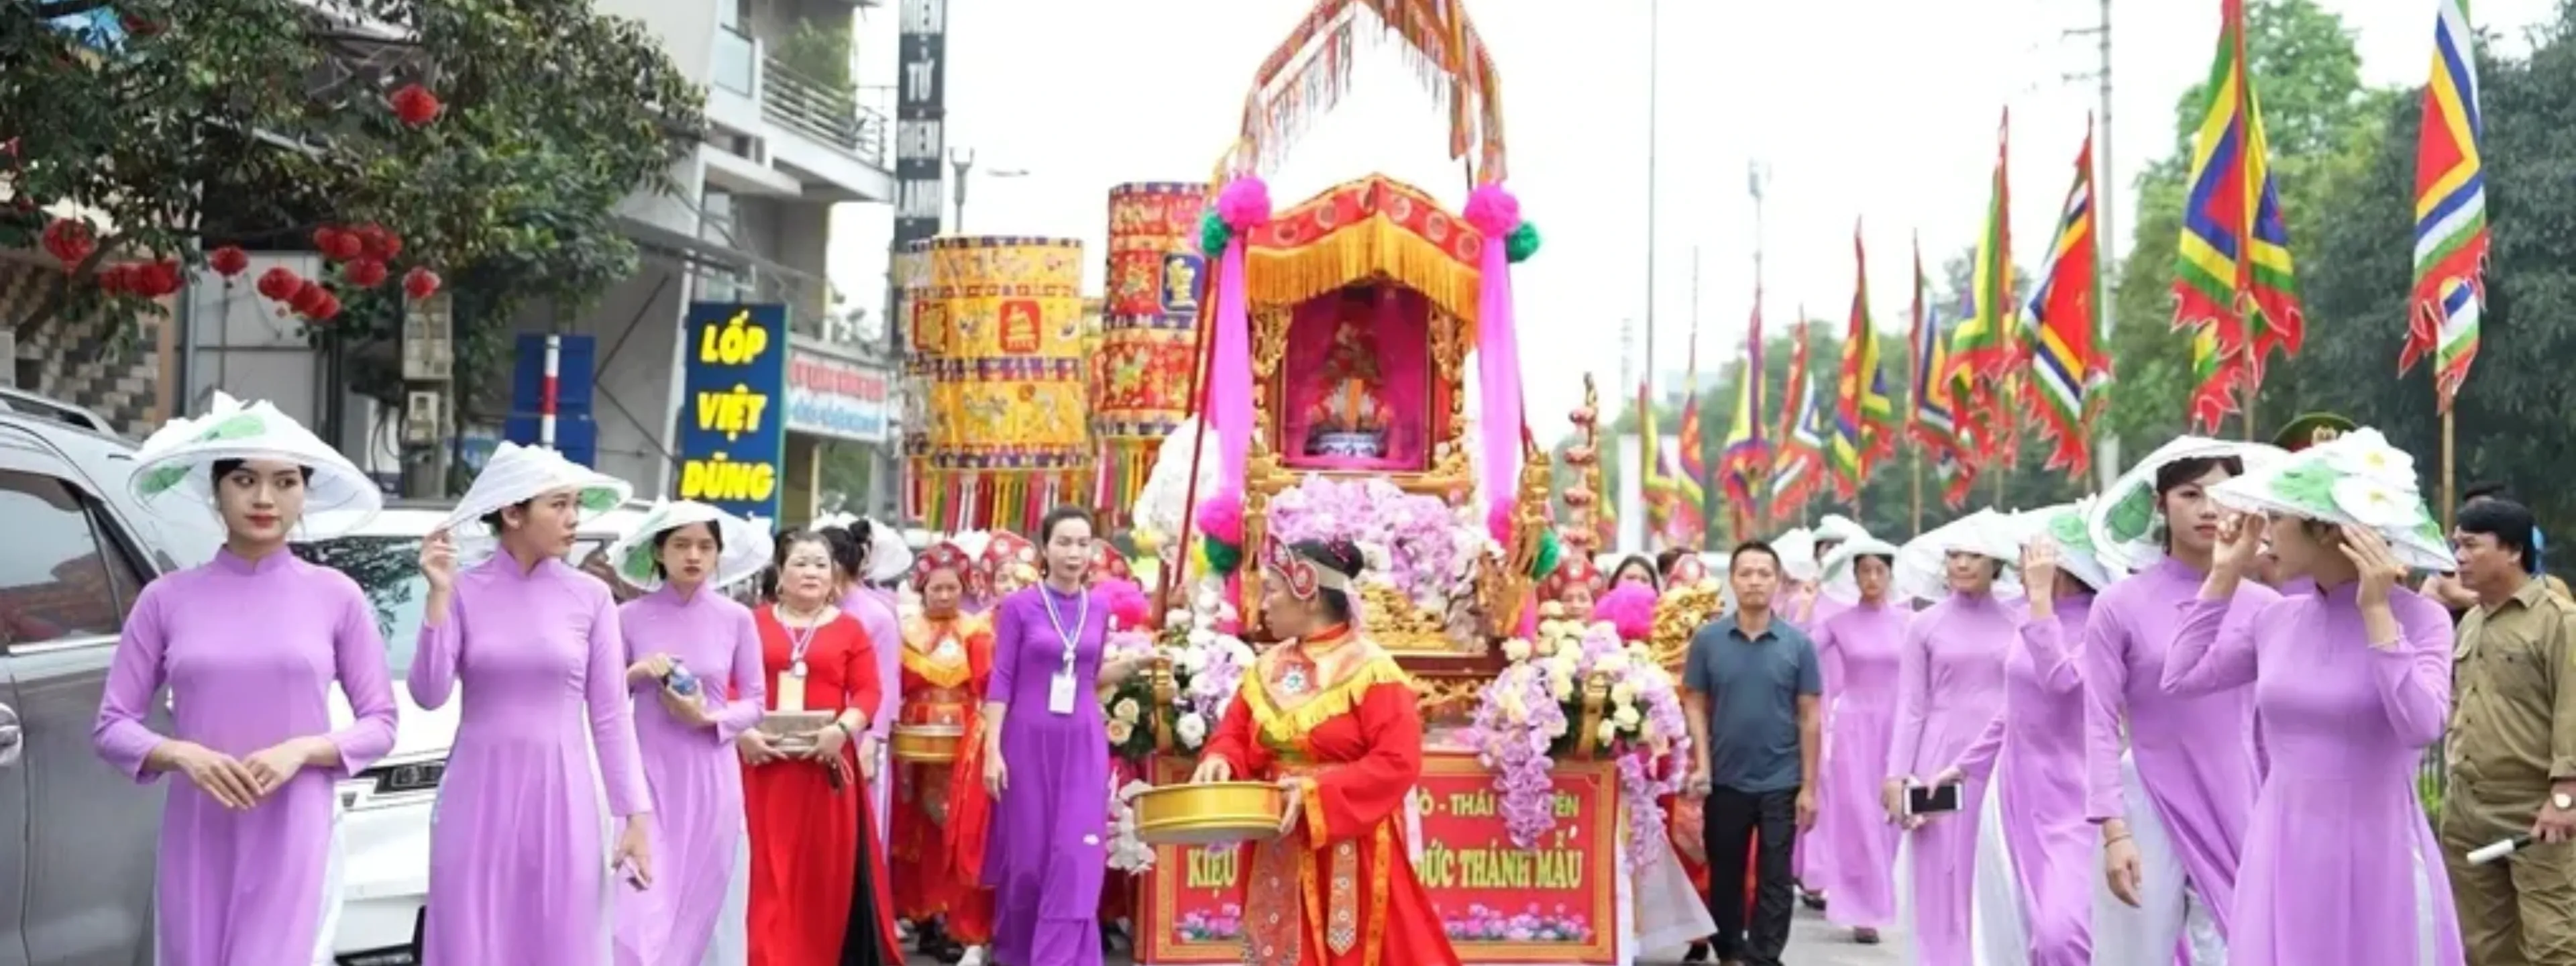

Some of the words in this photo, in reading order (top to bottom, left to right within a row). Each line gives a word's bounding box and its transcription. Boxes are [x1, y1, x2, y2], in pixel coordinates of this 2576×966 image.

[701, 309, 767, 364] LỐP
[698, 383, 767, 442] VIỆT
[680, 451, 775, 501] DŨNG
[1449, 788, 1495, 816] THÁI
[1458, 839, 1532, 888] THÁNH
